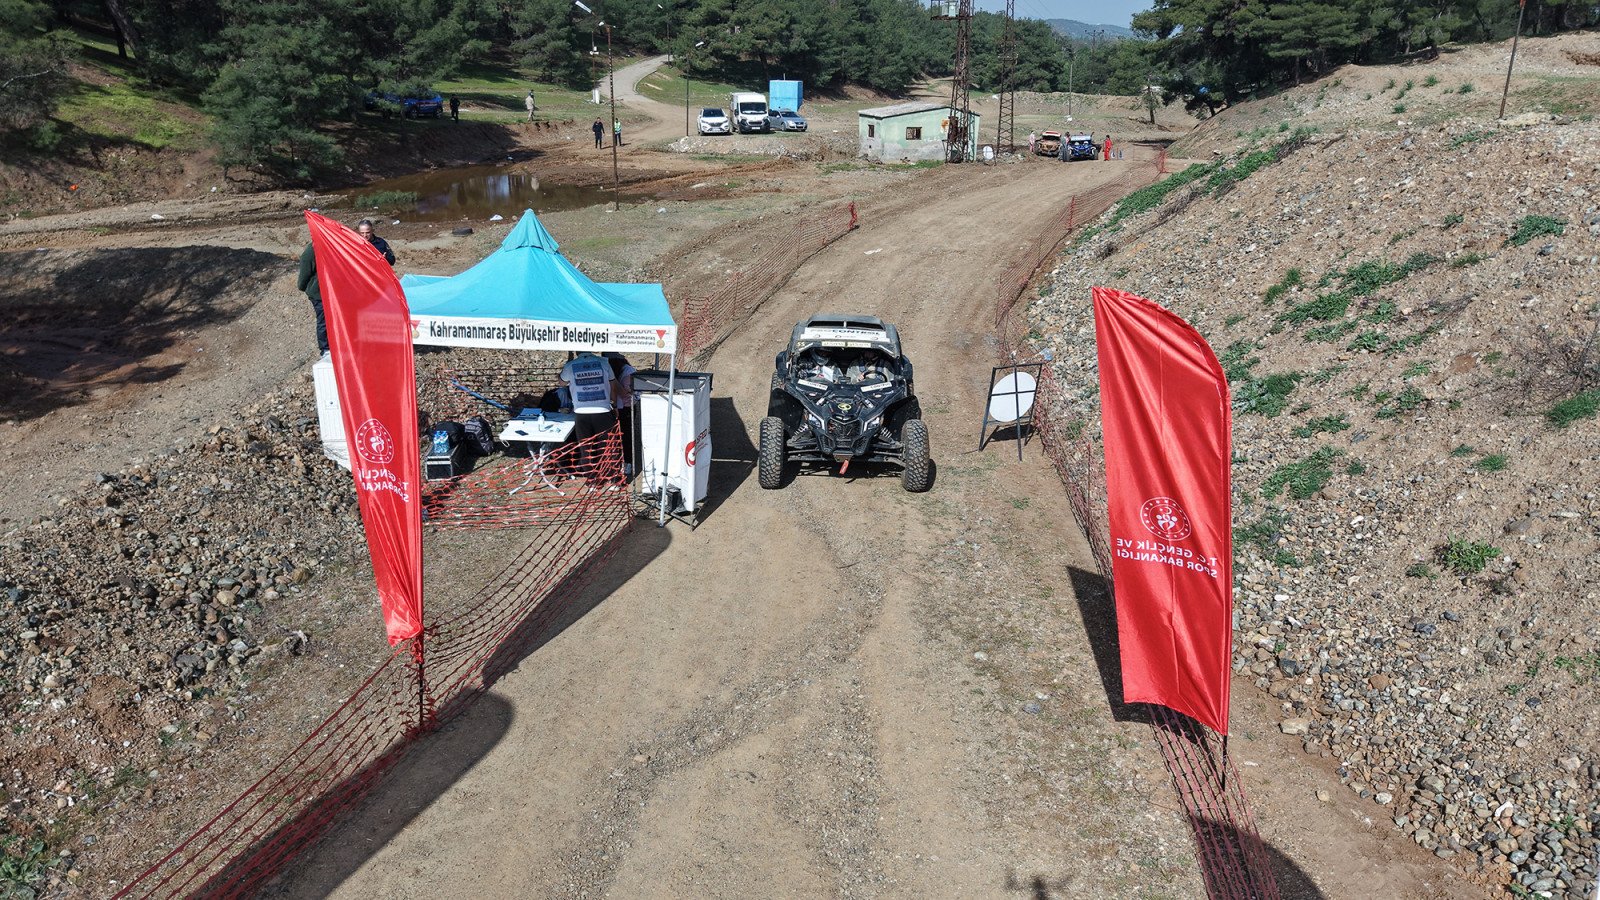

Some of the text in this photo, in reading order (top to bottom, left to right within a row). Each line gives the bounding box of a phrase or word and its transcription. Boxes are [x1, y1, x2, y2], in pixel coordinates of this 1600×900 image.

[430, 321, 609, 347] Kahramanmaraş Büyükşehir Belediyesi
